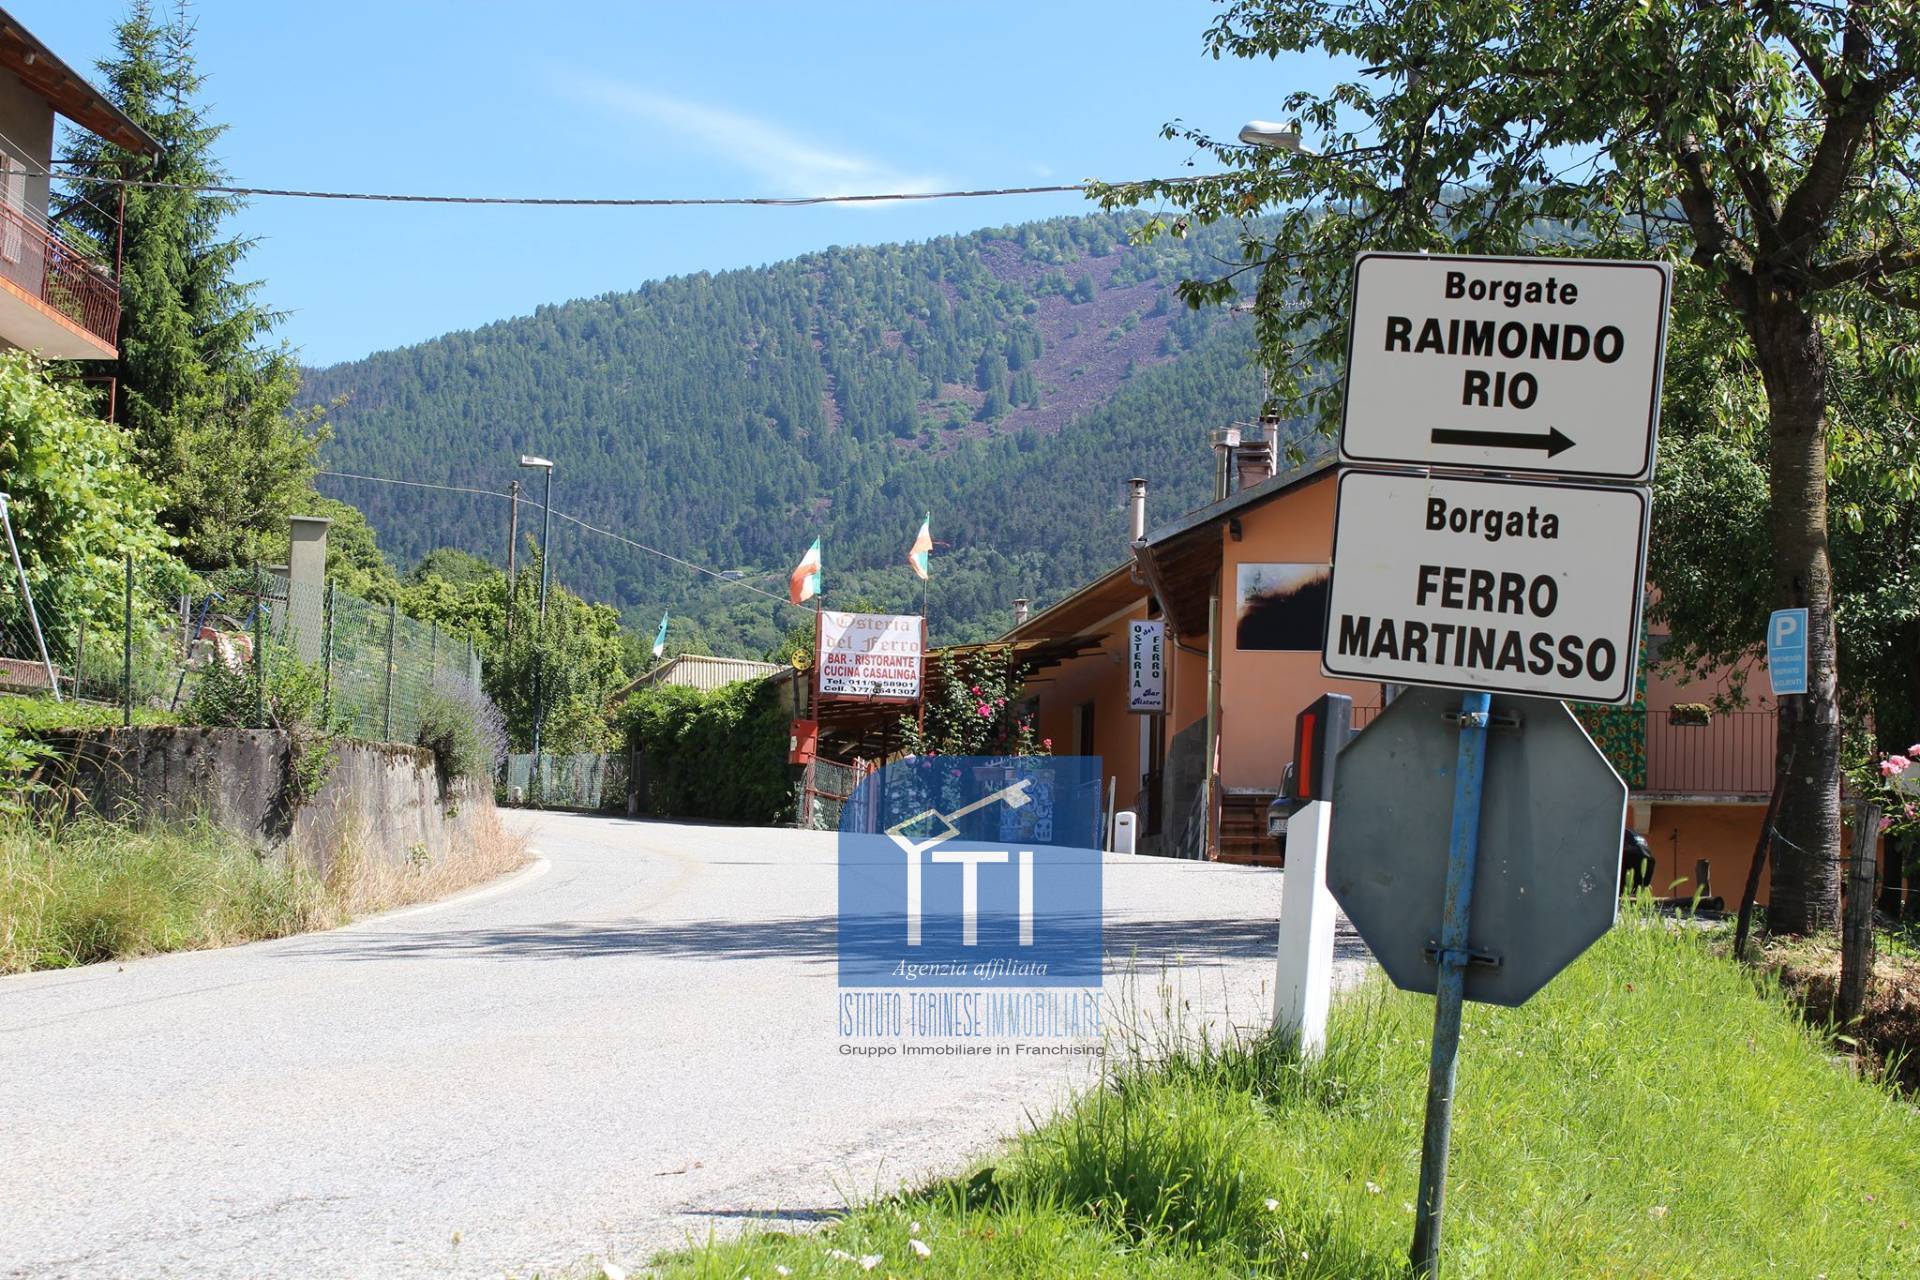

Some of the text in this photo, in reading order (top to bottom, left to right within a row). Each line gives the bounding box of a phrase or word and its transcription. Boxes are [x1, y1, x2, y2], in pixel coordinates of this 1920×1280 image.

[1444, 271, 1579, 309] Borgate
[1384, 315, 1625, 364] RAIMONDO
[1462, 369, 1539, 410] RIO
[1425, 497, 1560, 542] Borgata
[1416, 565, 1559, 618] FERRO
[836, 614, 910, 631] Osteria
[1143, 625, 1155, 636] del
[1776, 616, 1797, 646] P
[826, 634, 919, 652] del Ferro
[827, 653, 847, 664] BAR
[855, 655, 915, 668] RISTORANTE
[1133, 625, 1142, 688] OSTERIA
[1152, 635, 1160, 679] FERRO
[1338, 614, 1617, 682] MARTINASSO
[824, 665, 917, 680] CUCINA CASALINGA
[848, 679, 914, 688] 011/958901
